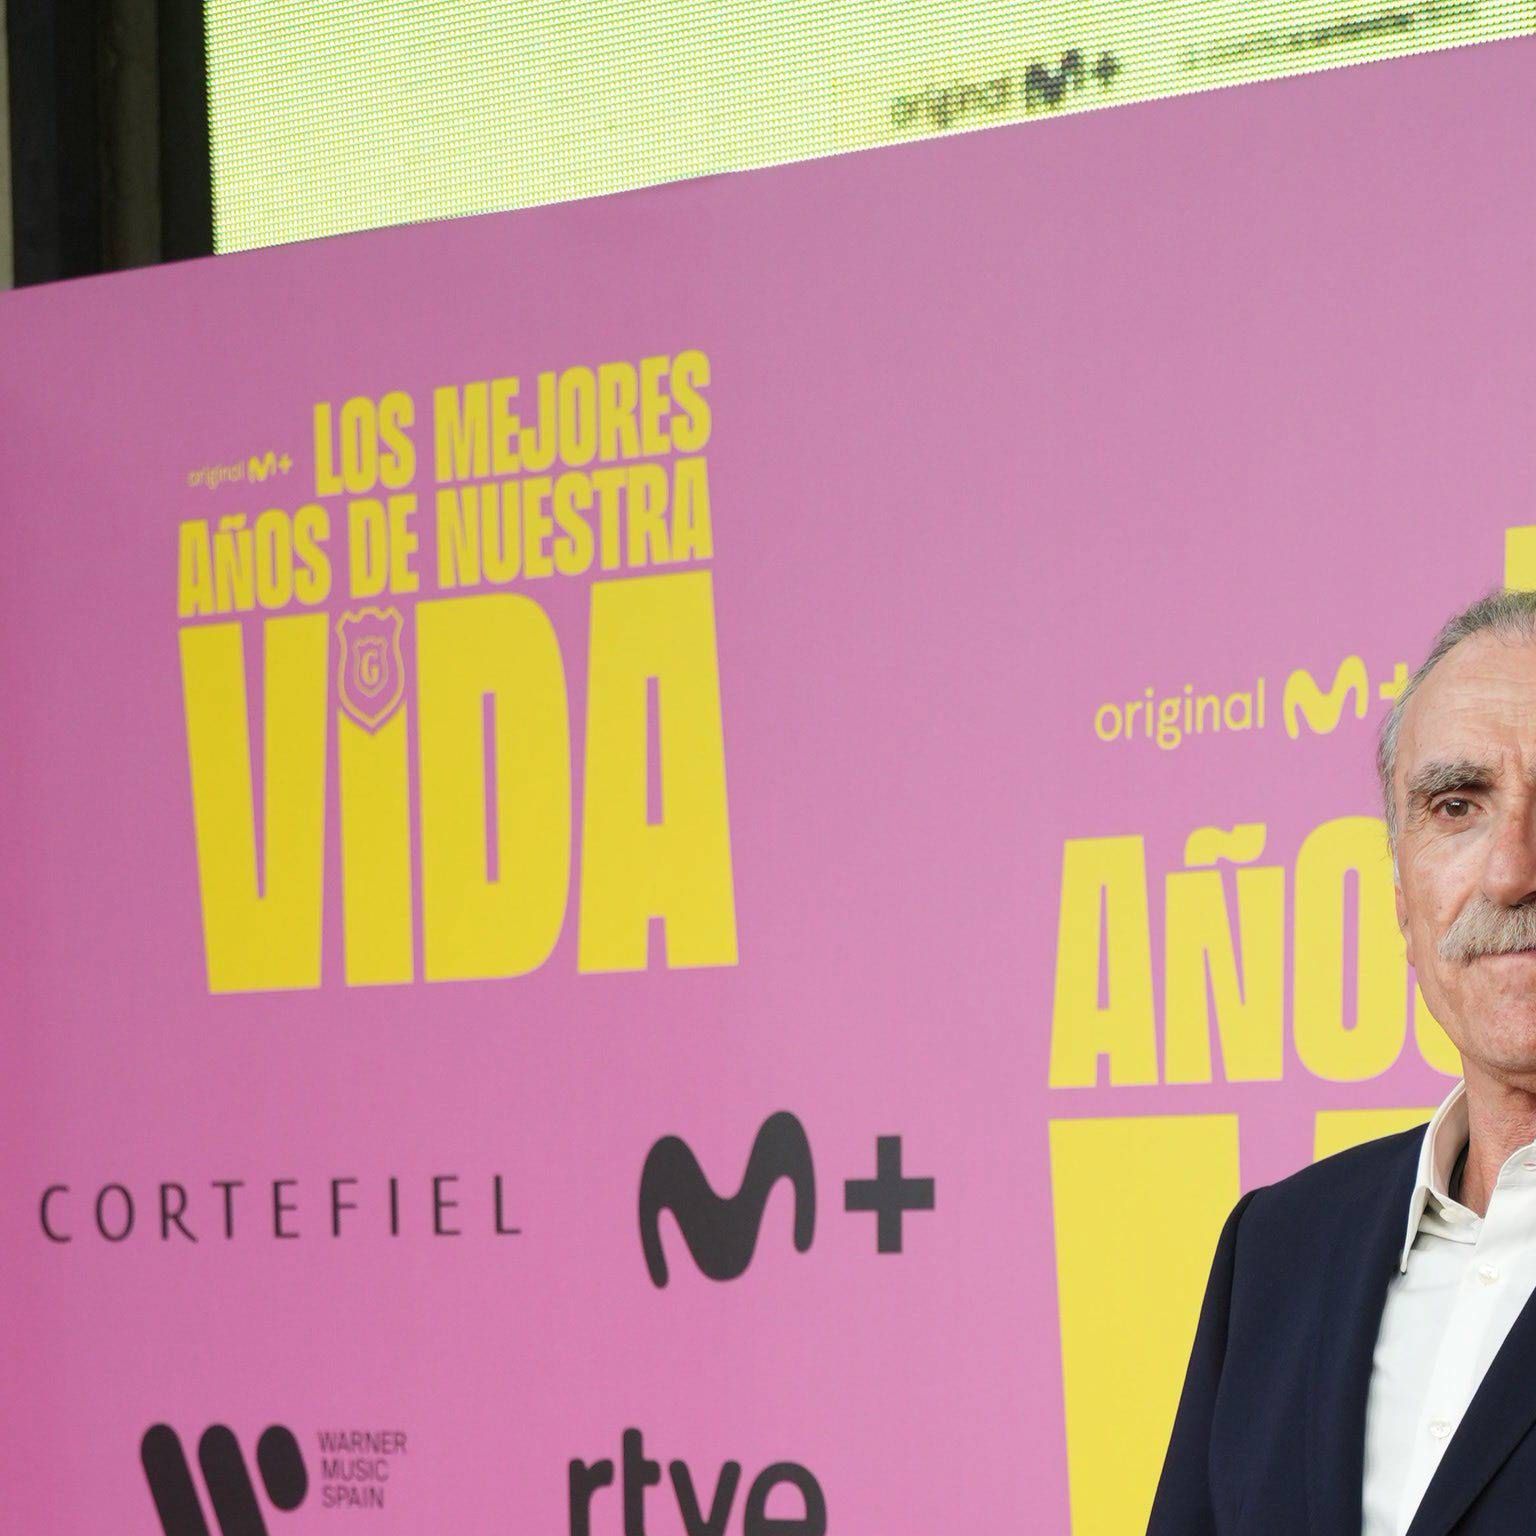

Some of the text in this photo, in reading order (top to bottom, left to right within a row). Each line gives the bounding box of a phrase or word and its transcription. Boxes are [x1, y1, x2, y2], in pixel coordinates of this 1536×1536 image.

[314, 349, 713, 497] LOS MEJORES
[177, 456, 714, 618] AÑOS DE NUESTRA
[1094, 677, 1265, 751] original
[1047, 816, 1464, 1089] AÑO
[38, 1175, 522, 1243] CORTEFIEL
[317, 1430, 408, 1455] WARNER
[321, 1458, 390, 1482] MUSIC
[321, 1486, 385, 1509] SPAIN
